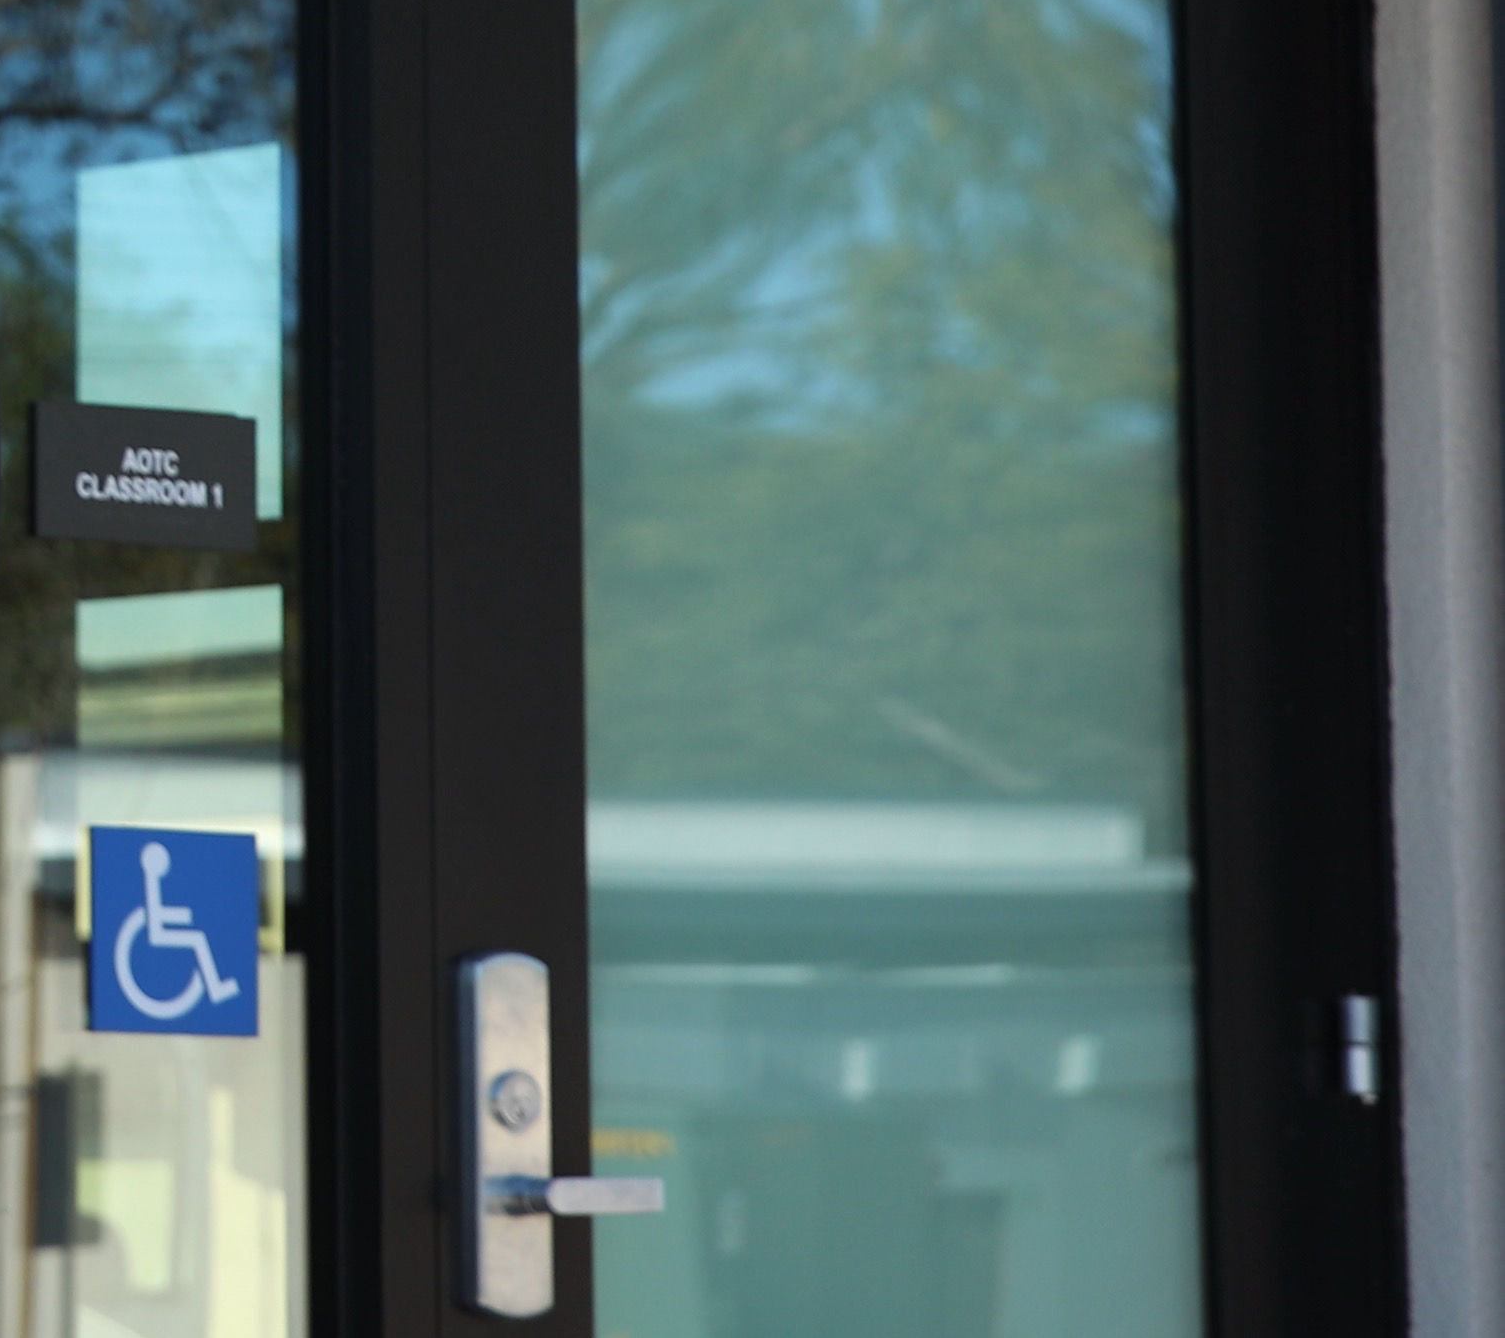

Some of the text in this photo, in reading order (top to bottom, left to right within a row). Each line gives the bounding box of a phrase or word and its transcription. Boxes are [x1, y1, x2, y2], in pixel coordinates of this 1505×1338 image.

[121, 446, 180, 477] AOTC
[75, 471, 224, 510] CLASSROOM 1
